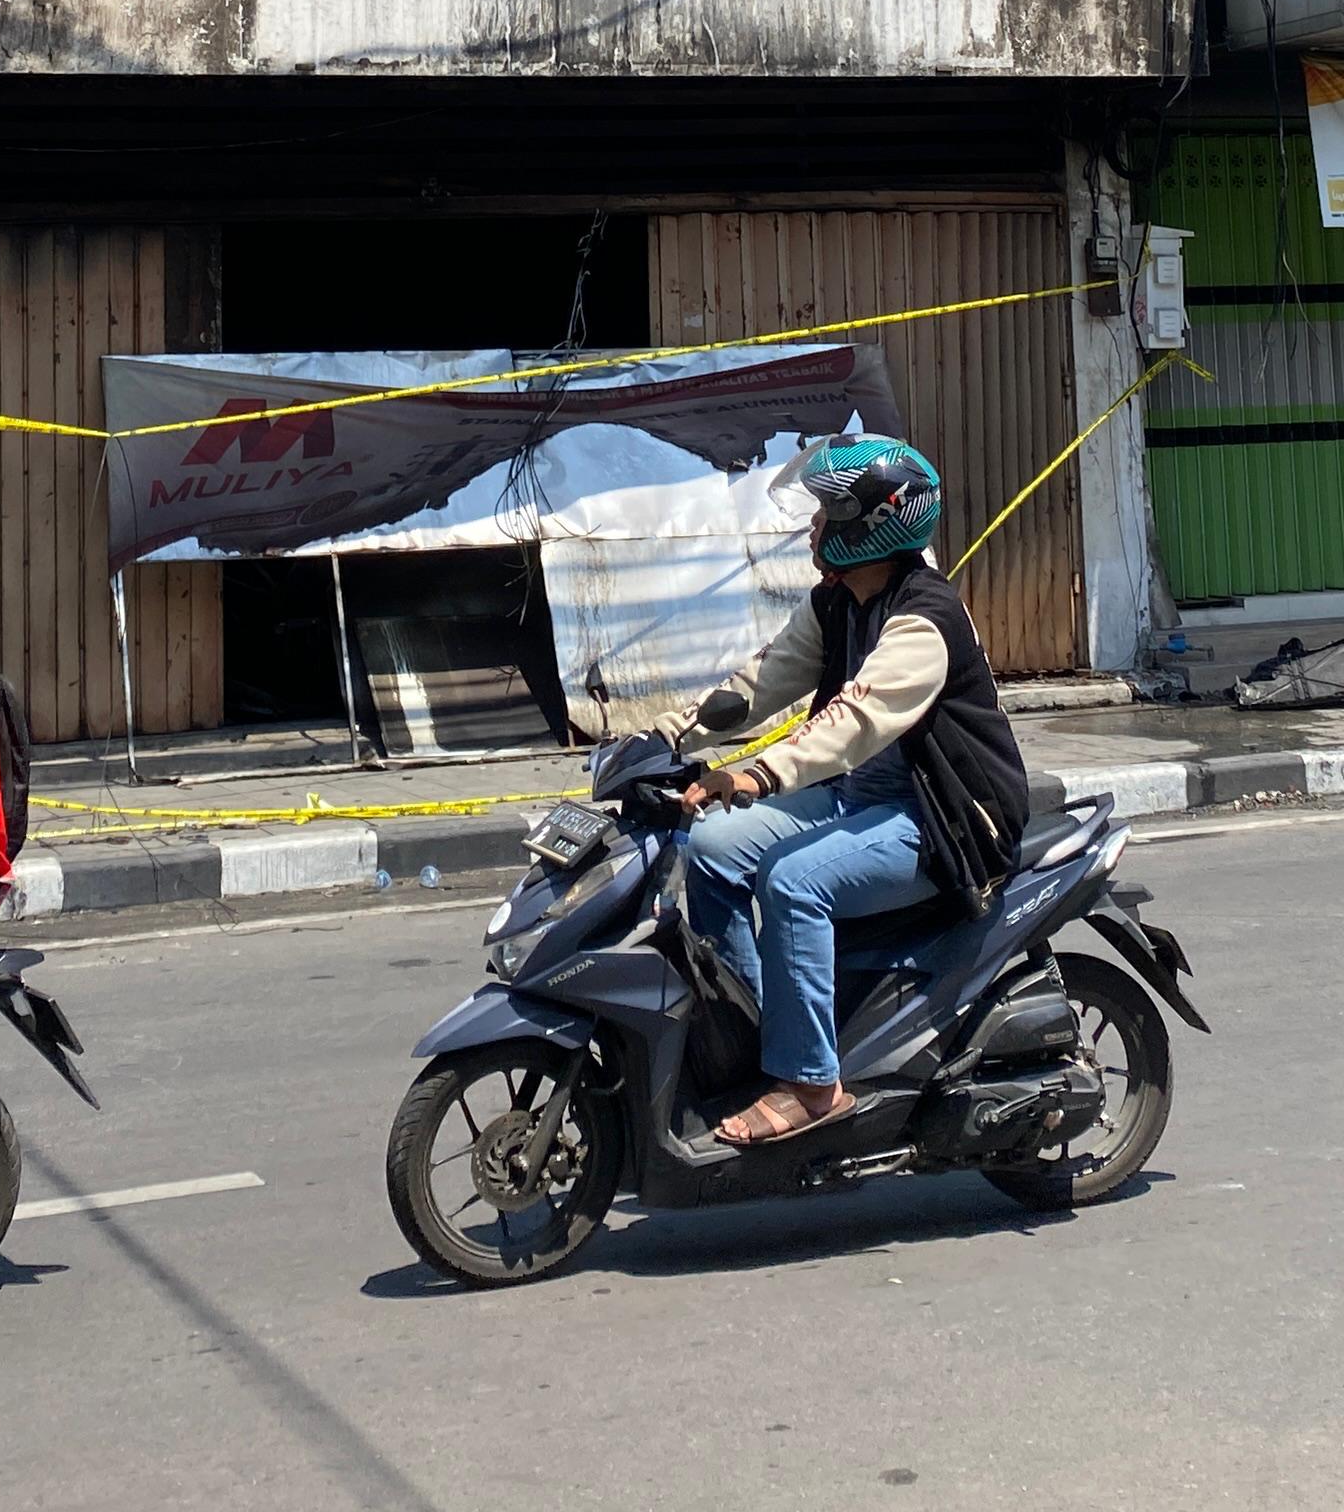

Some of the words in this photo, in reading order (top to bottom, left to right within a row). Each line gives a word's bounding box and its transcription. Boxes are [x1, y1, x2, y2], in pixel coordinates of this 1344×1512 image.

[716, 392, 848, 412] ALUMINIUM
[147, 461, 354, 510] MULIYA
[547, 959, 596, 987] HONDA
